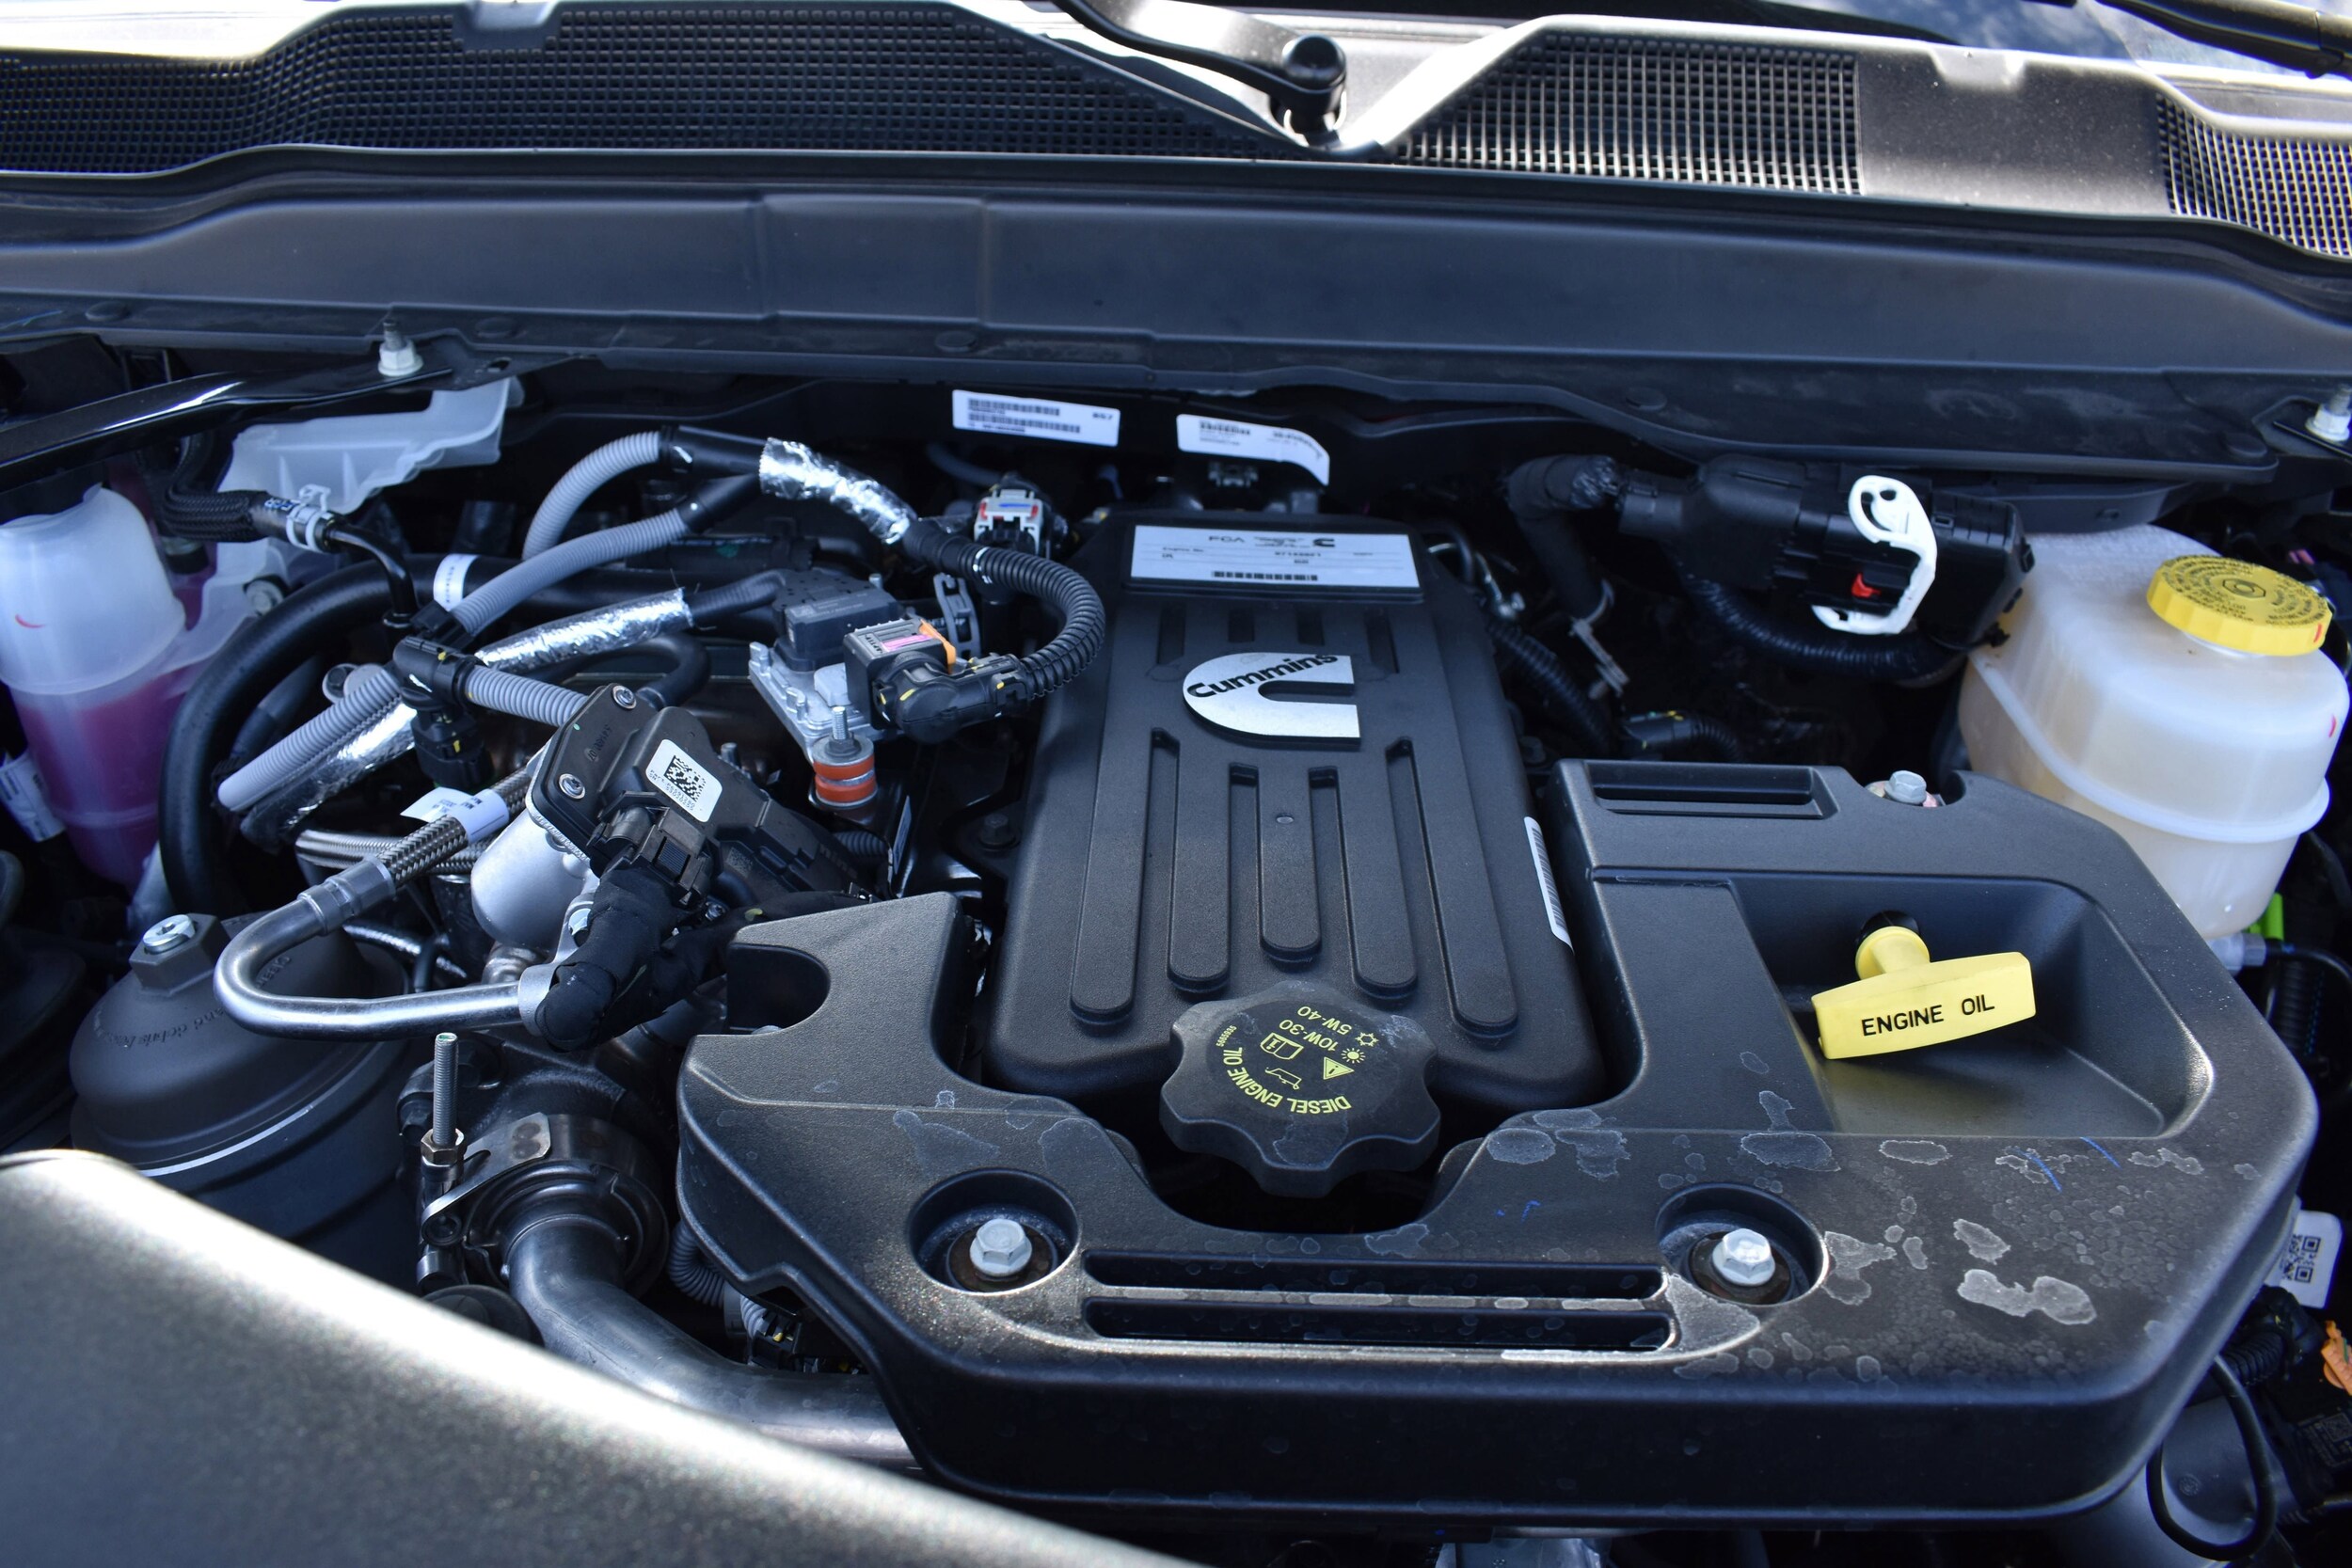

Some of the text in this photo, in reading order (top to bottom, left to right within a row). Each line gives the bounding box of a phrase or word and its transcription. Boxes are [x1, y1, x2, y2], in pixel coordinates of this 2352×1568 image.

[1186, 654, 1339, 698] Cummins
[1279, 1019, 1339, 1052] 10W-30
[1297, 1006, 1353, 1036] 5W-40
[1861, 994, 1995, 1037] ENGINE OIL
[1223, 1046, 1352, 1115] DIESEL ENGINE OIL
